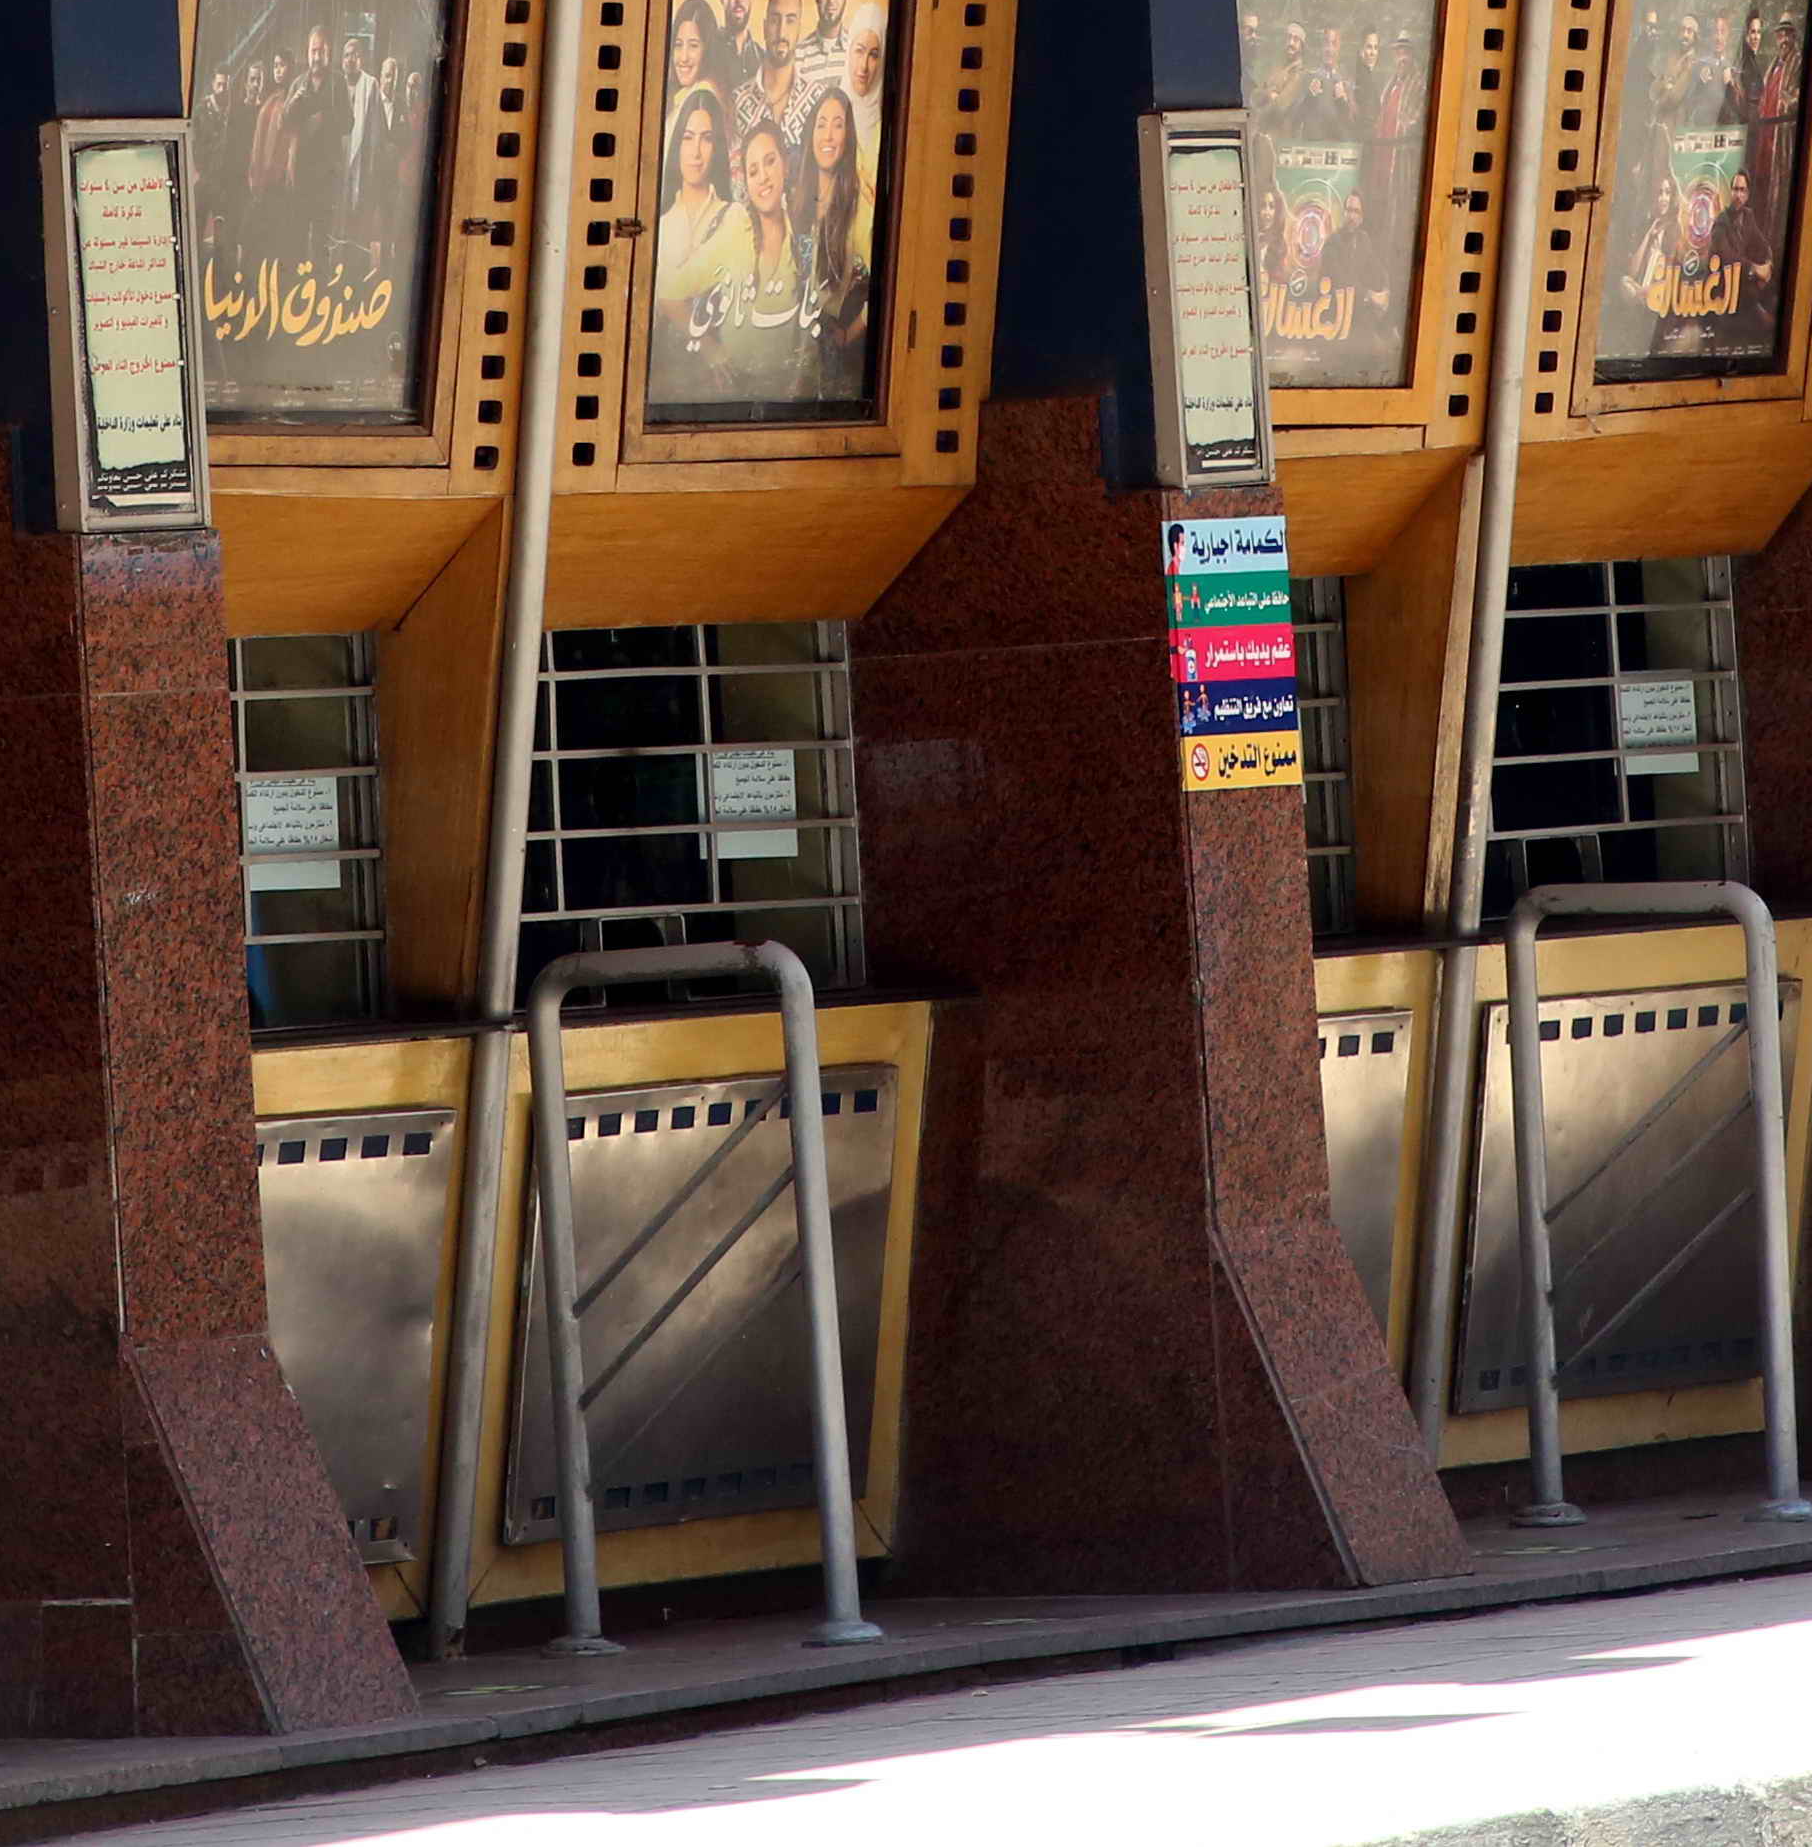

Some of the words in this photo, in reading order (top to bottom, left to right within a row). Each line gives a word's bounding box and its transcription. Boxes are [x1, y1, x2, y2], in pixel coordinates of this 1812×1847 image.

[1645, 255, 1742, 319] الغسالة
[1218, 742, 1261, 778] التدخين
[1264, 742, 1297, 775] ممنوع
